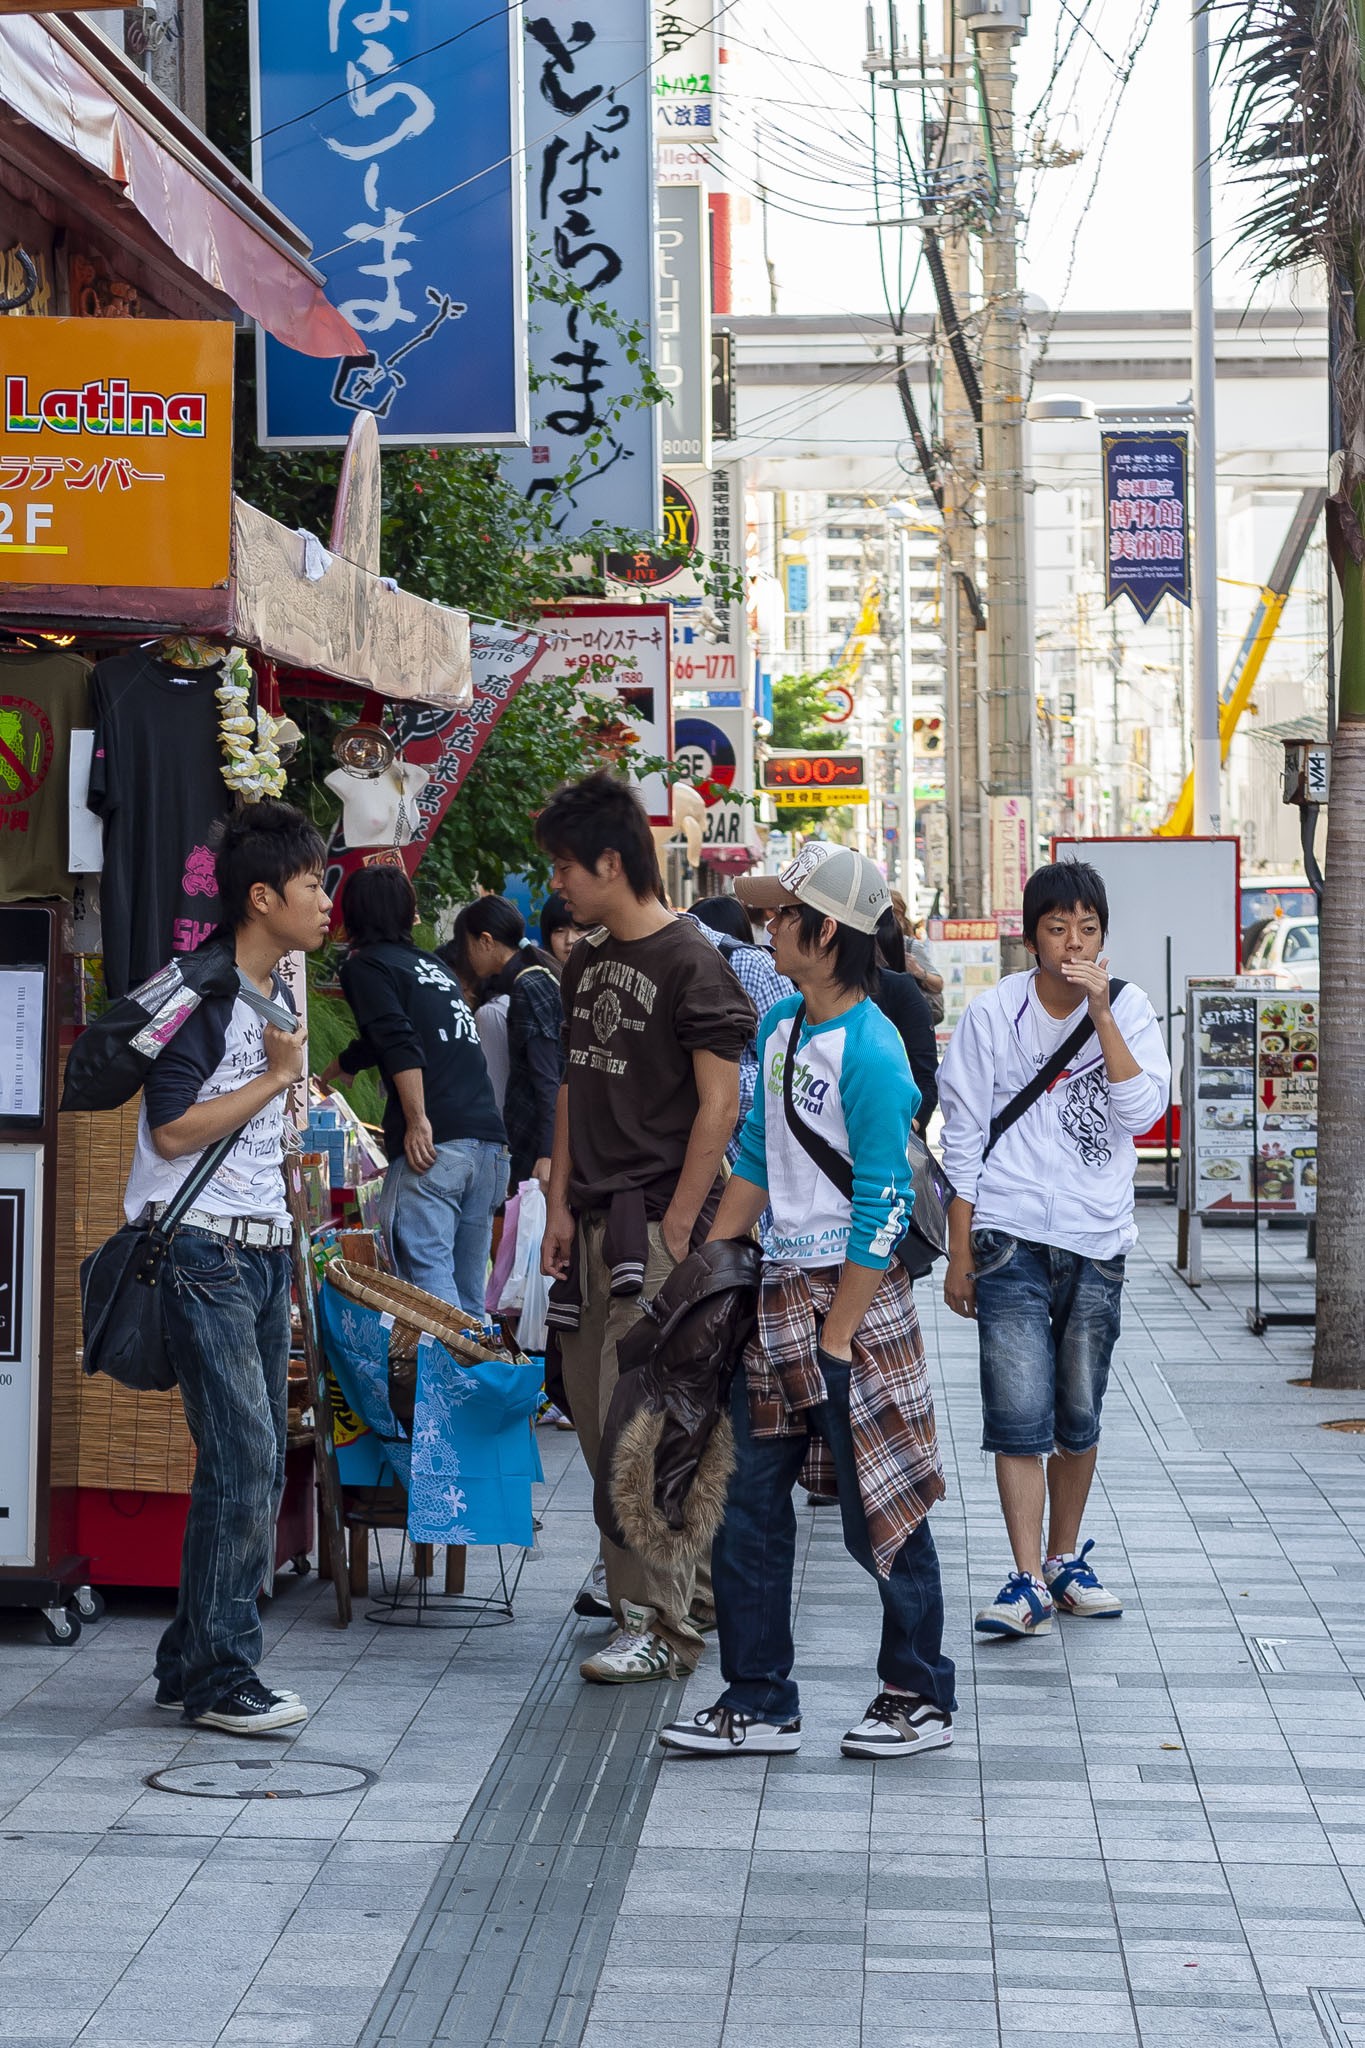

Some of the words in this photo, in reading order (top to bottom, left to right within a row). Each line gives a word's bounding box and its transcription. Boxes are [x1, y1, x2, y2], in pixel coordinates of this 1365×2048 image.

[5, 375, 207, 438] Latina
[0, 456, 165, 492] ラテンバー
[1116, 478, 1175, 498] 沖縄県立
[1109, 499, 1184, 529] 博物館
[1109, 530, 1185, 560] 美術館
[626, 569, 658, 581] LIVE
